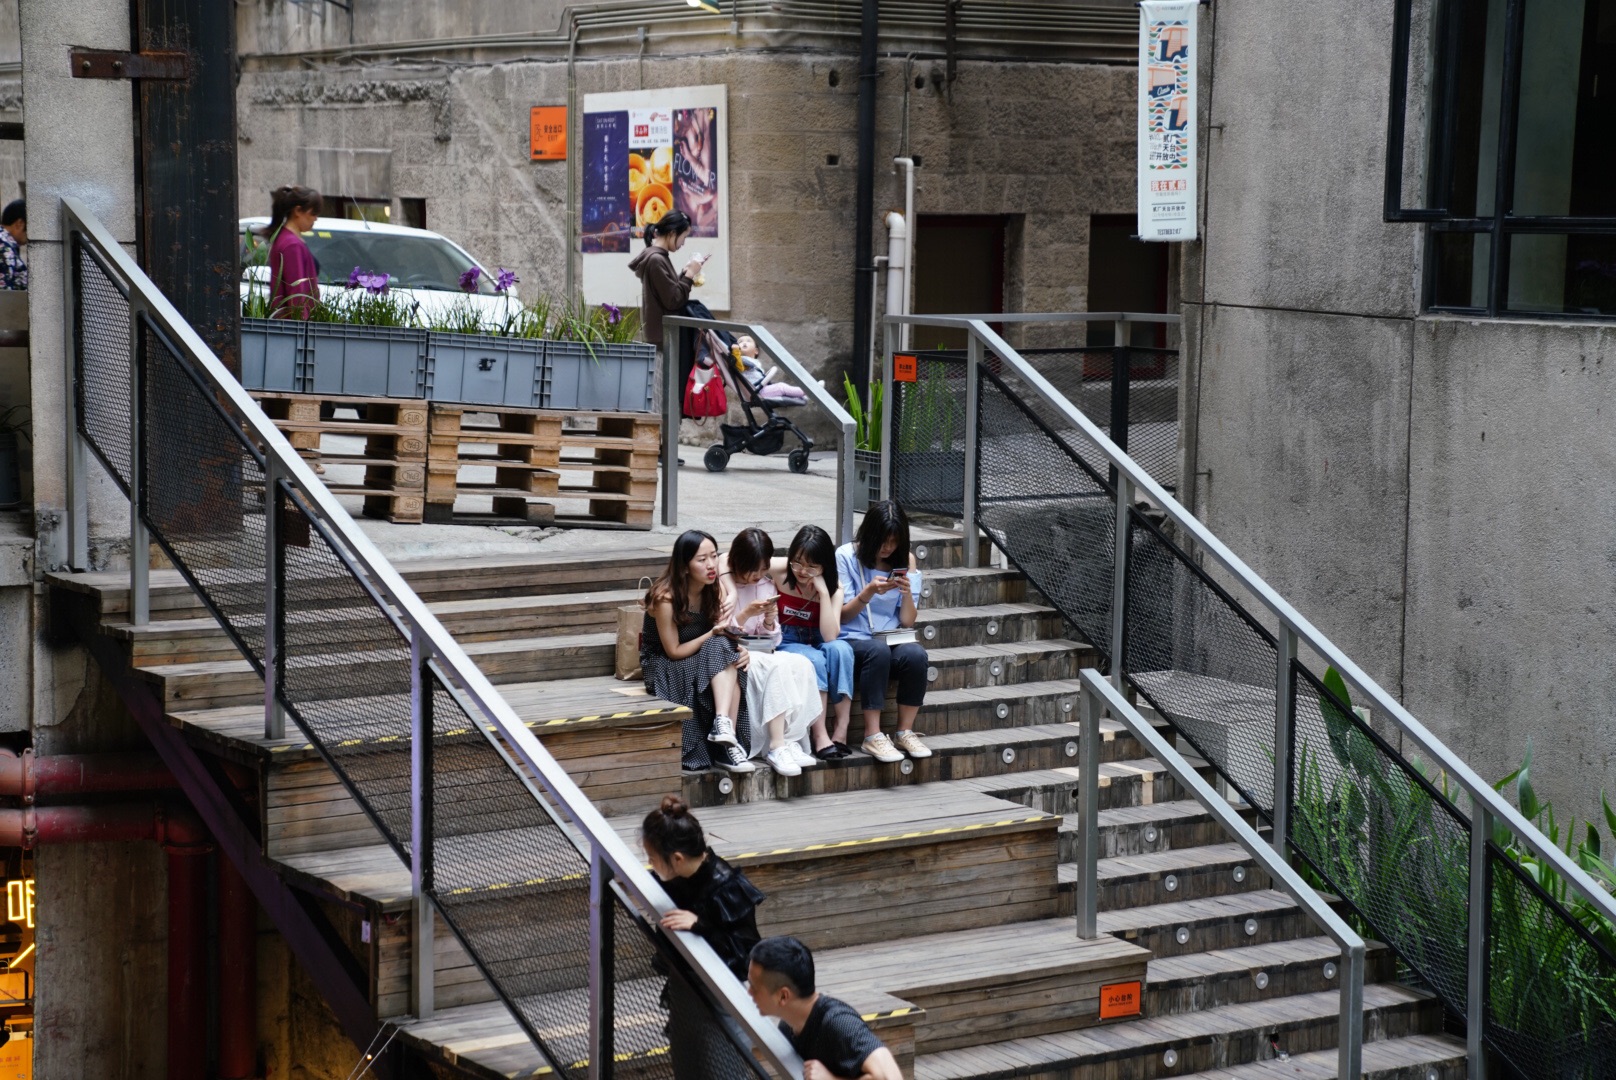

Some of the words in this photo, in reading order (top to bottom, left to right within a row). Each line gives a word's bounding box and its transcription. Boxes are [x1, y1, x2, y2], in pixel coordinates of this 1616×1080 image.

[544, 125, 562, 133] 安全出口
[1162, 144, 1176, 152] 天台
[674, 153, 716, 190] FLOWR
[407, 414, 420, 422] EUR
[1108, 993, 1133, 1003] 小心台阶
